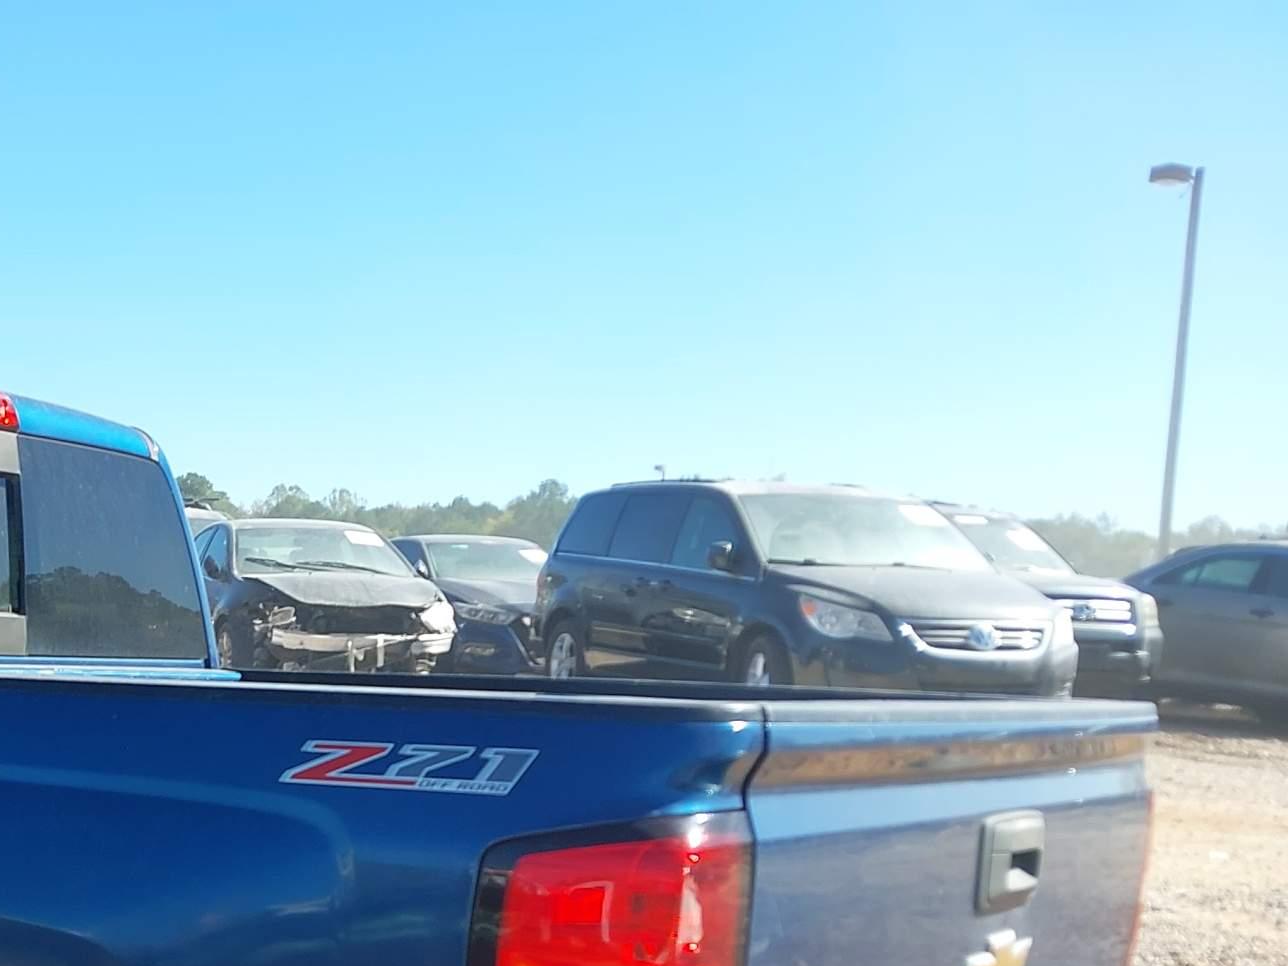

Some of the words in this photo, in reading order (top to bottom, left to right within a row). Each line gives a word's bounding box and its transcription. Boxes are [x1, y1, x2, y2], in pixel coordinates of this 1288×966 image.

[278, 739, 541, 793] Z71
[417, 779, 451, 789] OFF
[455, 782, 510, 793] ROAD
